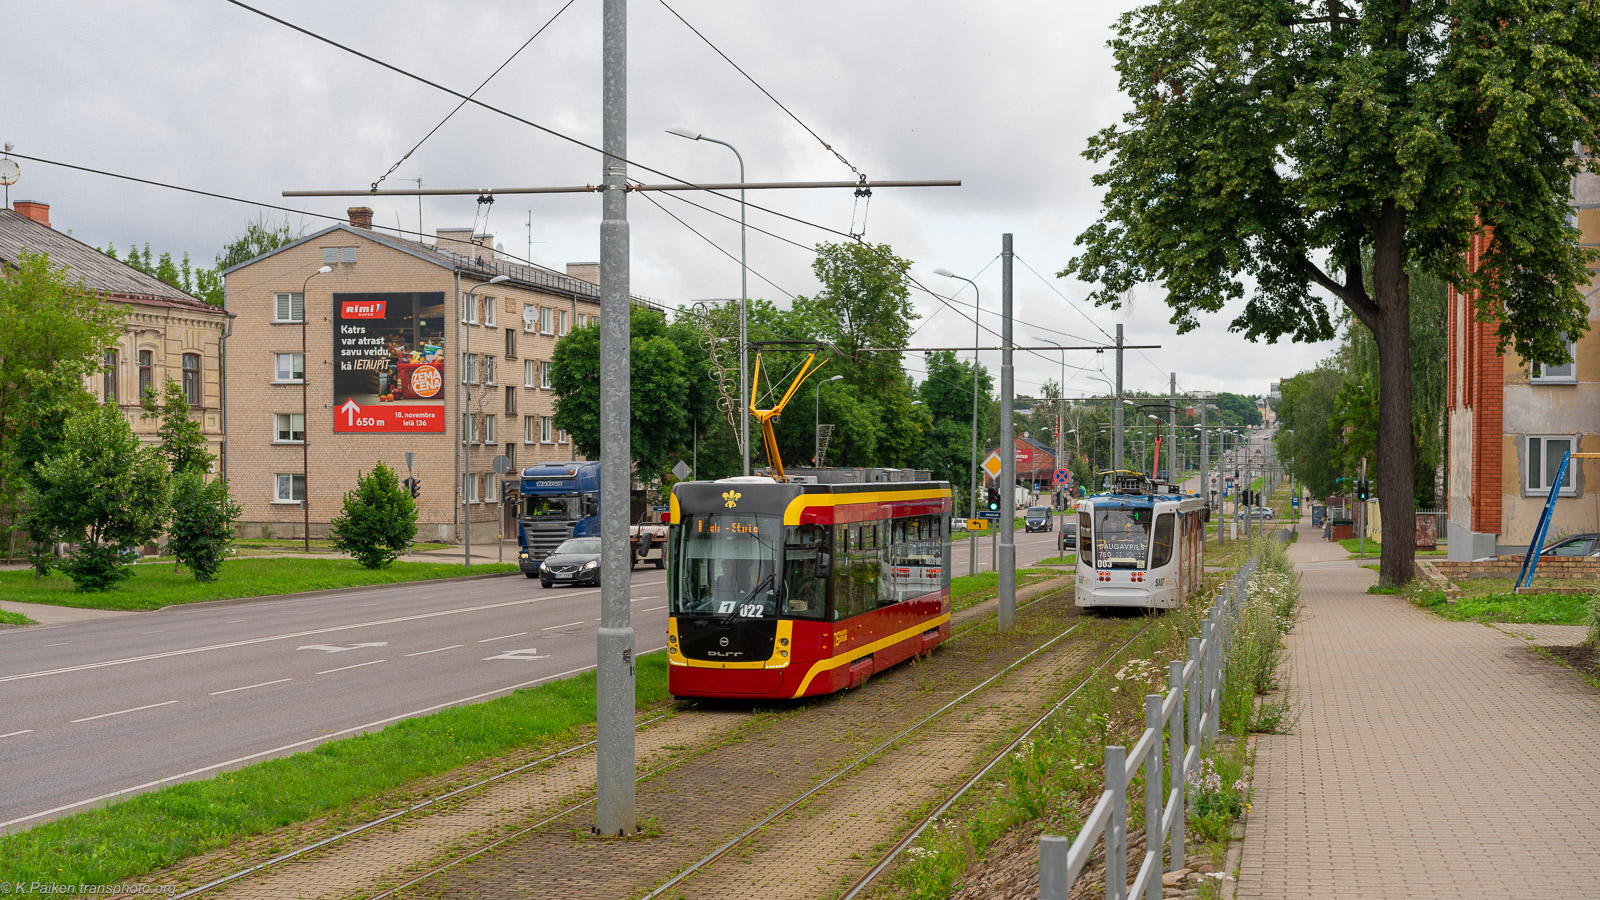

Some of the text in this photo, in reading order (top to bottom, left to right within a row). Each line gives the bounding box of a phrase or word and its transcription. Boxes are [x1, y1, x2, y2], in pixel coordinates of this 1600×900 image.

[341, 325, 366, 334] Katrs
[358, 337, 385, 345] atrast
[364, 348, 391, 357] veidu,
[341, 358, 390, 370] kā IETAUPĪT
[413, 371, 440, 382] ZEMA
[414, 378, 440, 392] CENA
[356, 418, 375, 426] 650
[724, 603, 764, 618] 1 022
